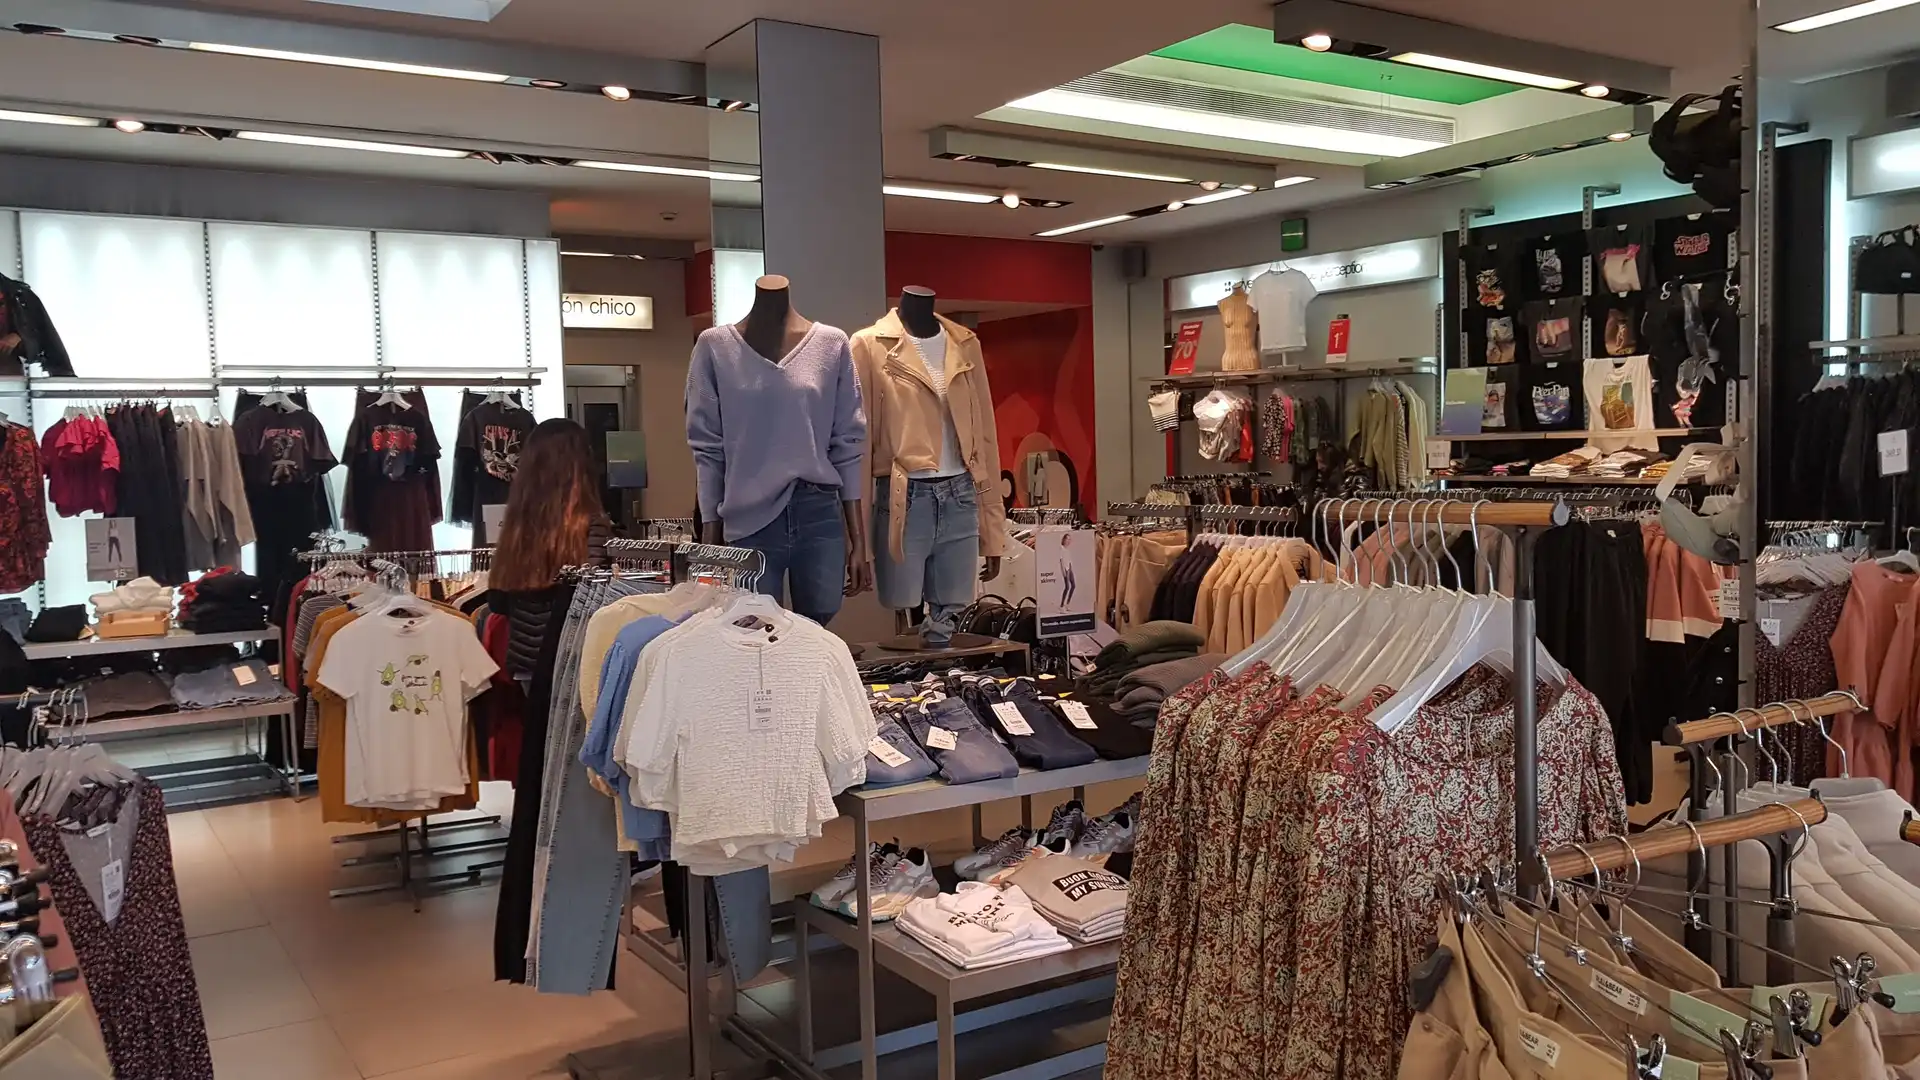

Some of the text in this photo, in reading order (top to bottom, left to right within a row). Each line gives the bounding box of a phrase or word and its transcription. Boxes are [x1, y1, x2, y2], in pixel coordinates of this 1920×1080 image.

[589, 297, 636, 316] chico
[1060, 872, 1088, 888] BUON
[1070, 884, 1088, 899] MY
